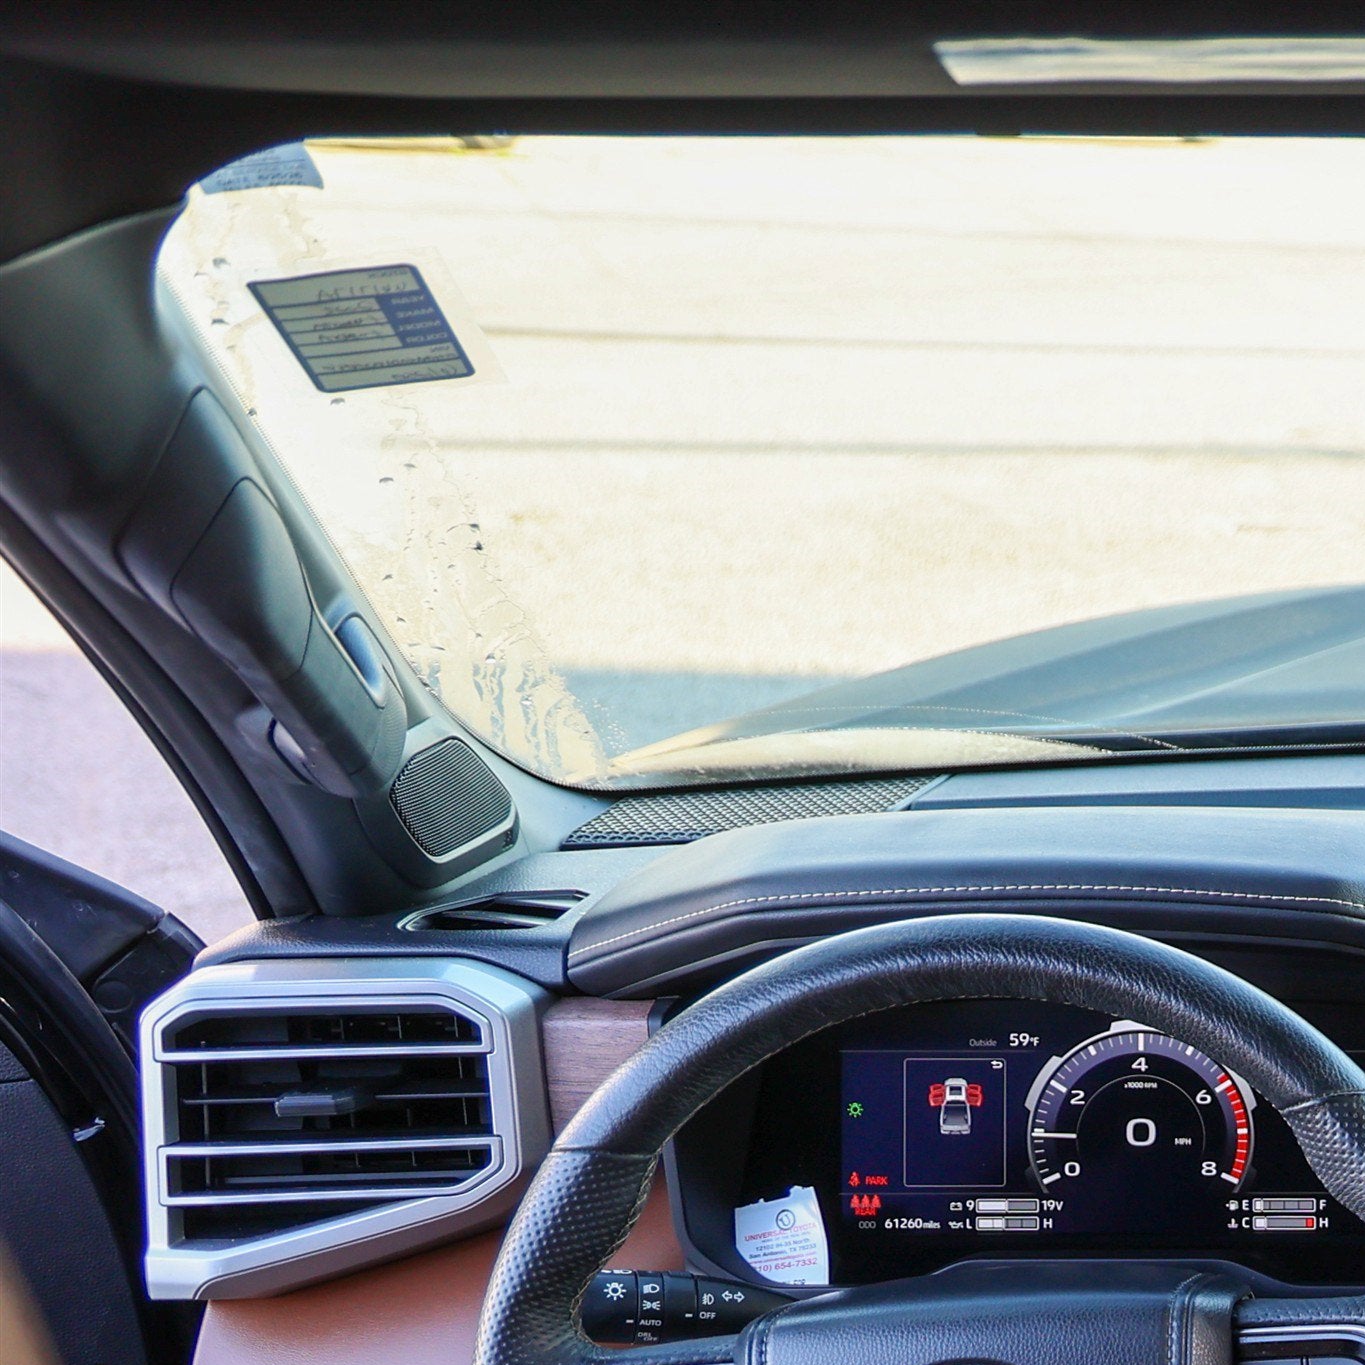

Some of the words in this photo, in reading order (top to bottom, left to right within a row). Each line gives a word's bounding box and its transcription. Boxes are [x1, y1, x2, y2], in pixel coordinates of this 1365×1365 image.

[969, 1039, 997, 1047] Outside
[1131, 1057, 1149, 1072] 4
[1069, 1090, 1085, 1105] 2
[1196, 1090, 1212, 1105] 6
[1126, 1118, 1157, 1147] 0
[1175, 1138, 1192, 1146] MPH
[1064, 1161, 1081, 1177] 0
[1201, 1161, 1217, 1176] 8
[866, 1177, 888, 1185] PARK
[966, 1201, 975, 1211] 9
[1041, 1200, 1064, 1211] 19V
[1242, 1200, 1250, 1211] E
[1319, 1200, 1327, 1211] F
[966, 1219, 973, 1230] L
[1043, 1218, 1053, 1229] H
[1242, 1217, 1250, 1228] C
[1319, 1218, 1329, 1229] H
